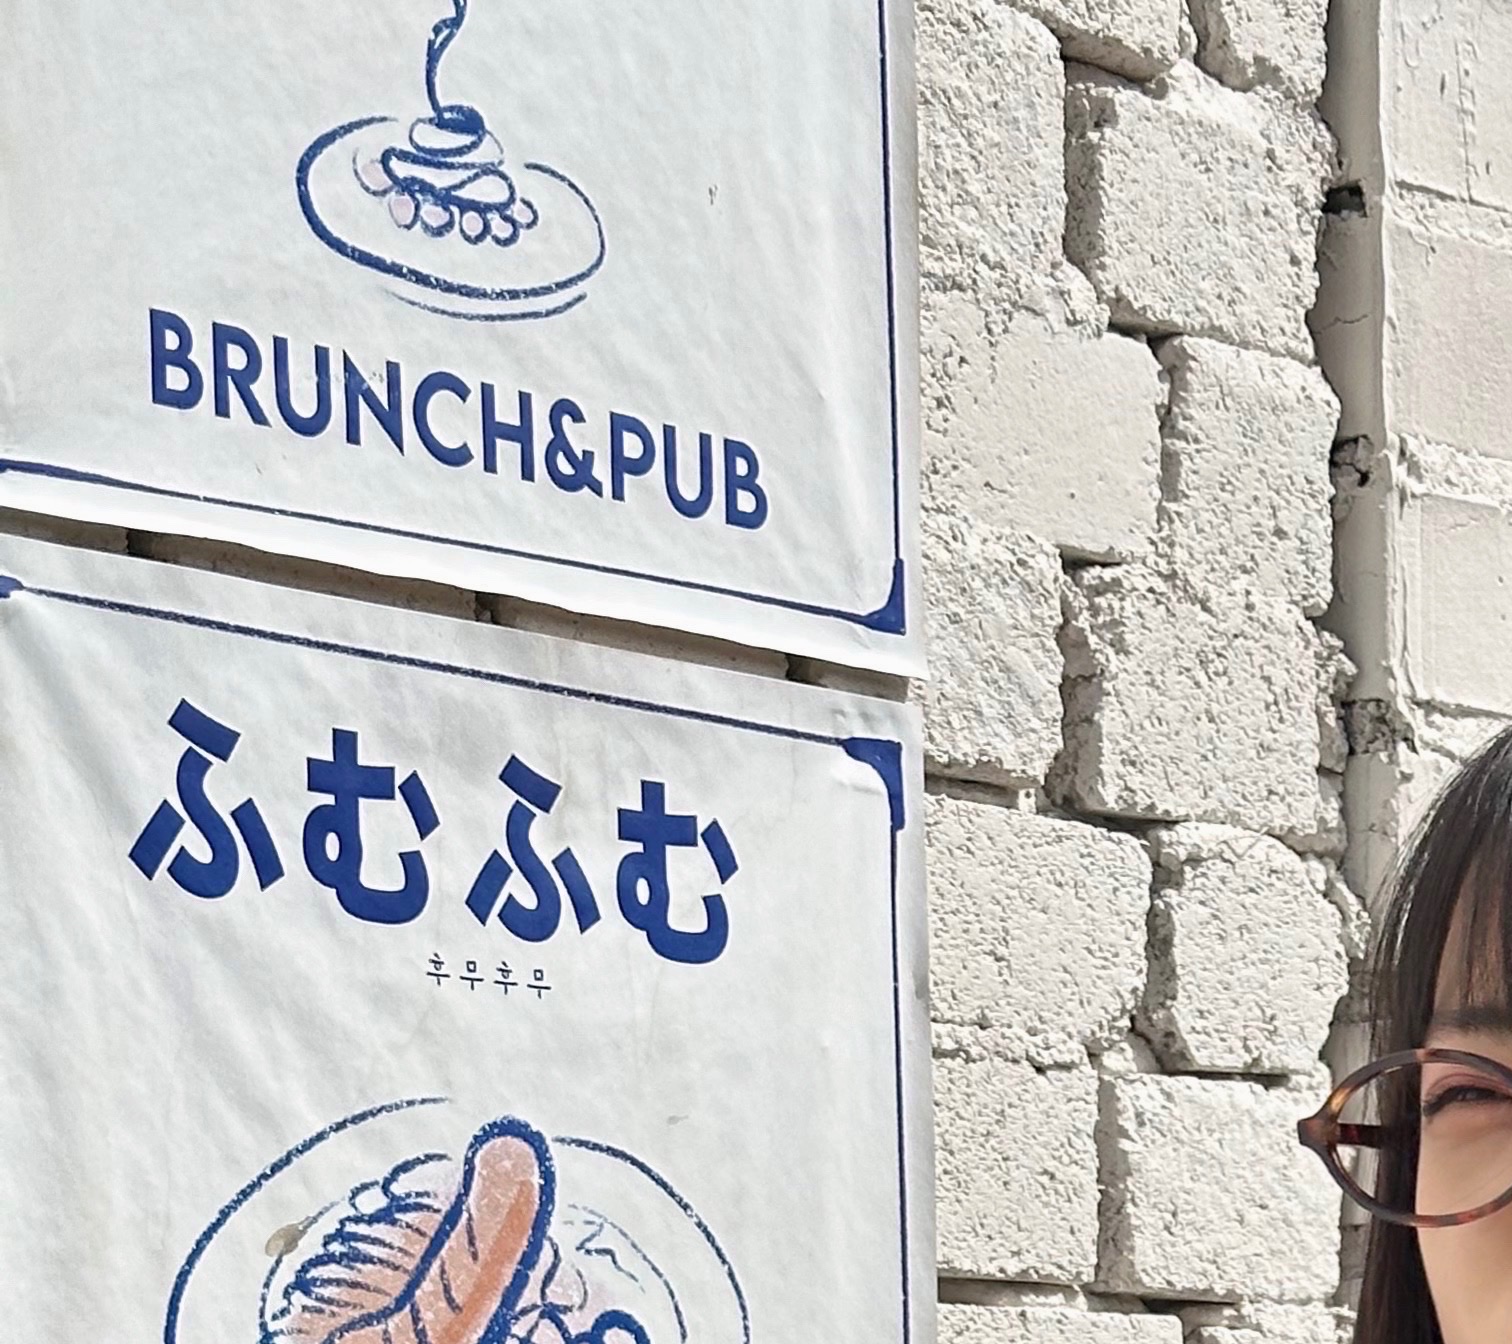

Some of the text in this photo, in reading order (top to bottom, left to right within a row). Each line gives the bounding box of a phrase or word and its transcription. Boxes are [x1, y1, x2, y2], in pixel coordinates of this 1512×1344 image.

[149, 308, 769, 530] BRUNCH&PUB
[129, 698, 738, 964] ふむふむ
[426, 952, 552, 999] 후무후무
